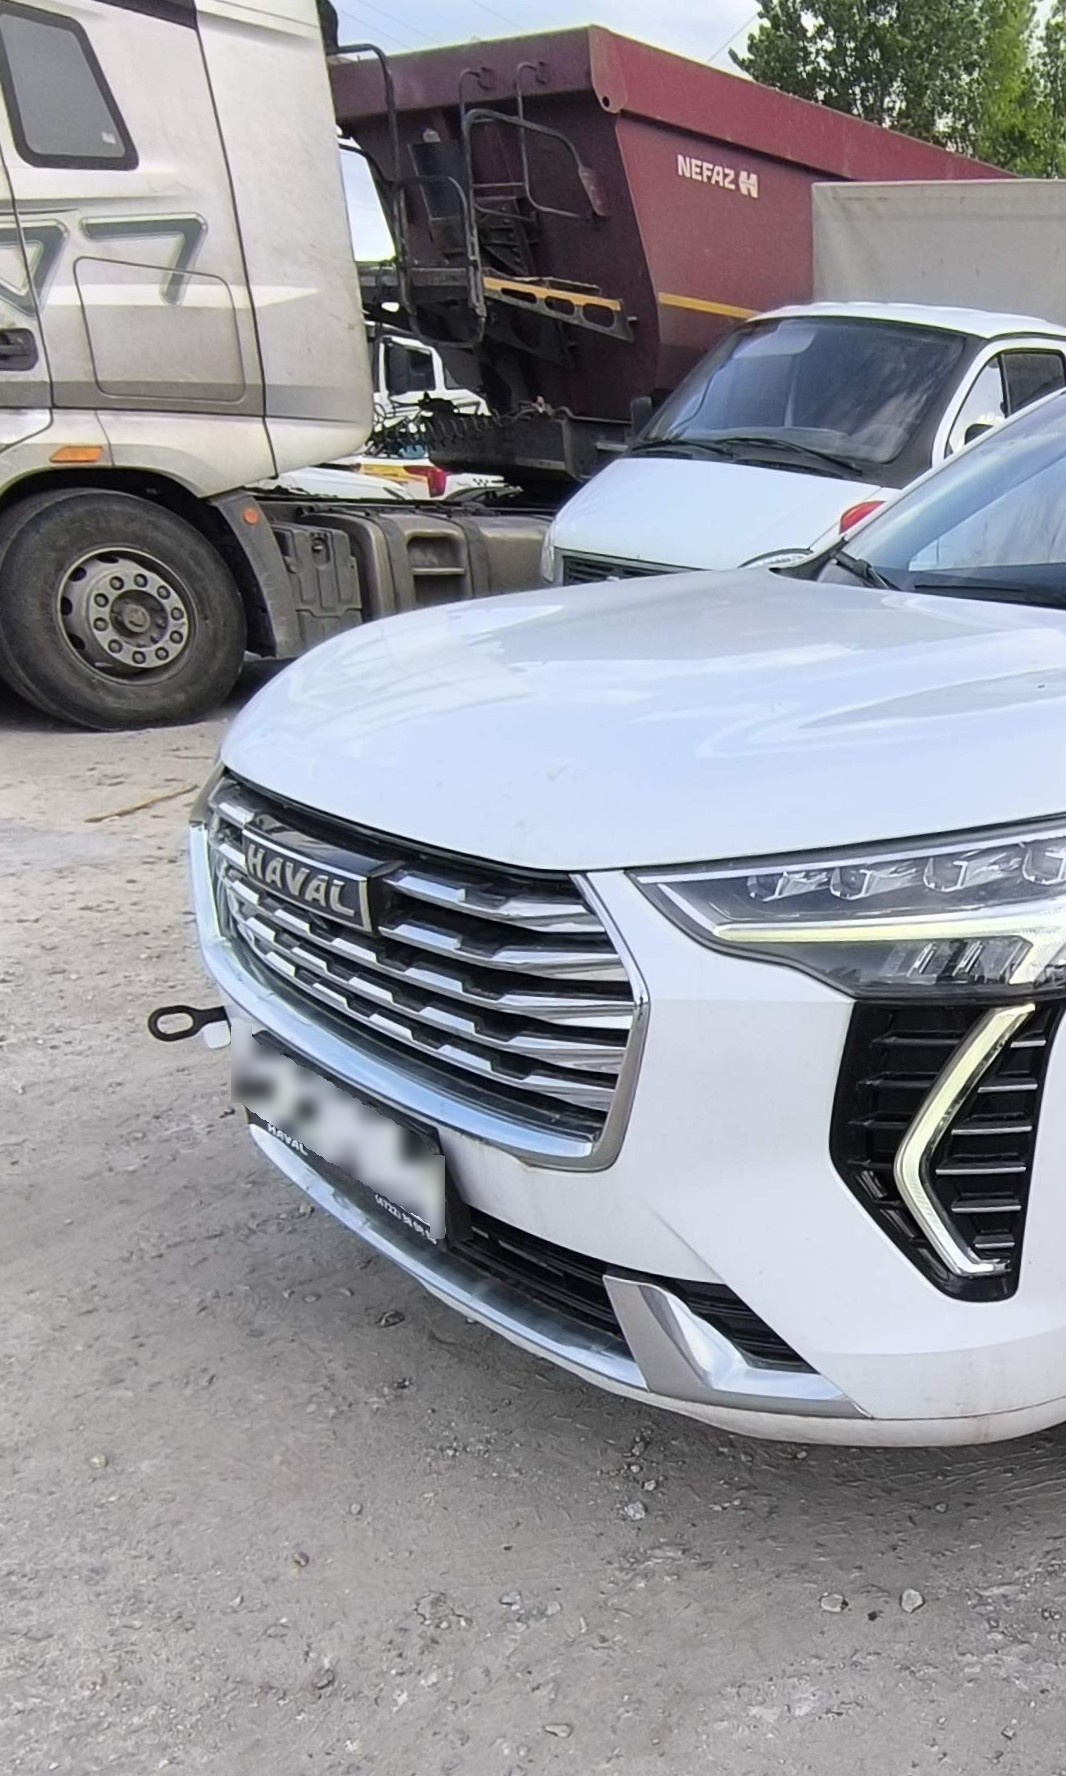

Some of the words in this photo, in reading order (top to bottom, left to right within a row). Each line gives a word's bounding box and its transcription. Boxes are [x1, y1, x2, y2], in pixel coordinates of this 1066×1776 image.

[677, 154, 736, 190] NEFAZ
[247, 843, 355, 917] HAVAL
[267, 1122, 308, 1156] HAVAL
